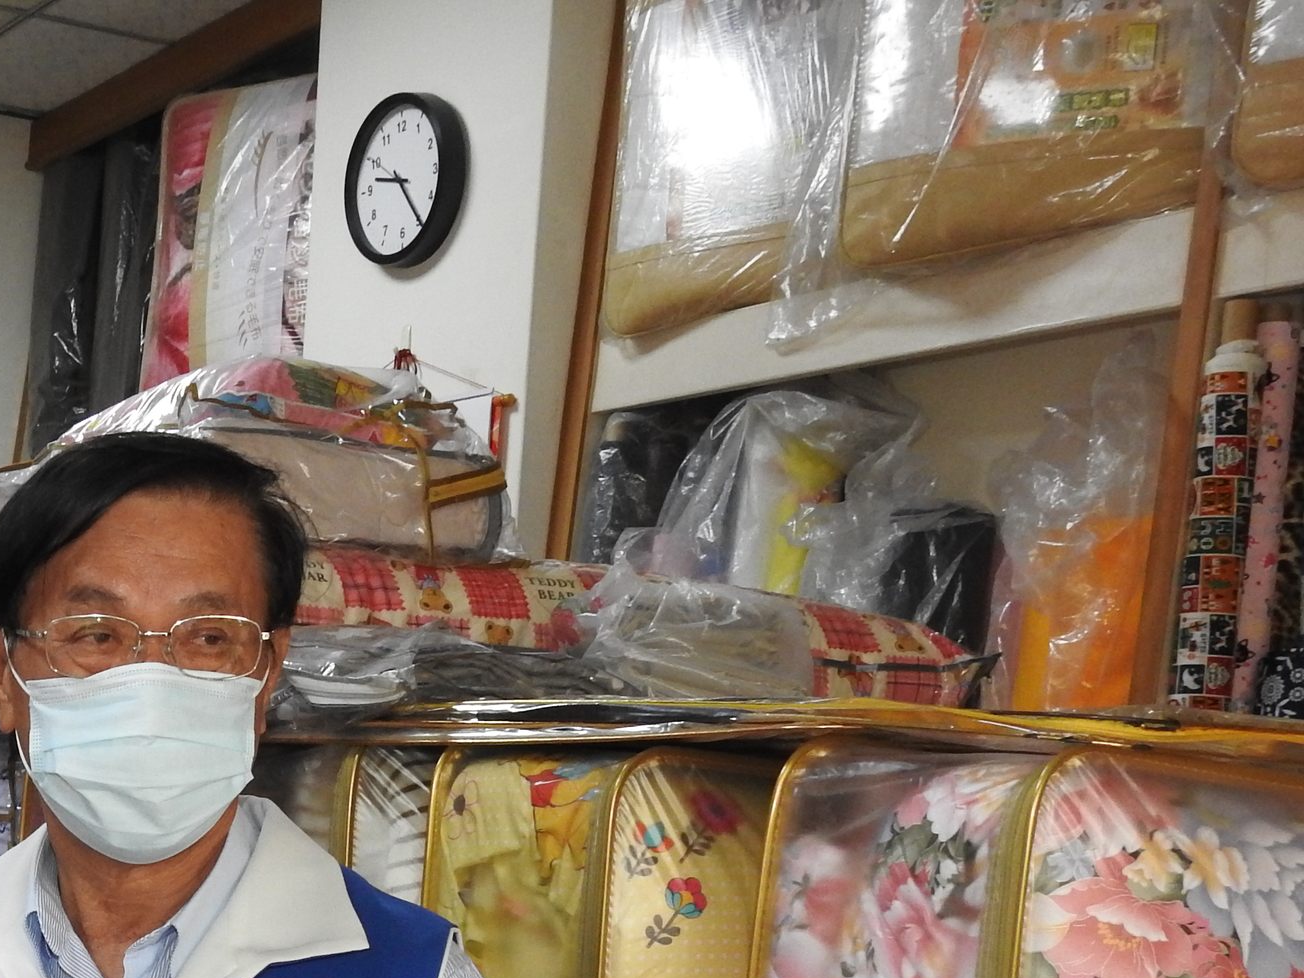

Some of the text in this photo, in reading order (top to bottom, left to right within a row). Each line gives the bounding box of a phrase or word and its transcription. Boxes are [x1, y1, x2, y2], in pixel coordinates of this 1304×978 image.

[397, 120, 407, 133] 12
[382, 134, 391, 146] 11
[427, 138, 433, 150] 2
[371, 157, 382, 170] 10
[432, 163, 438, 175] 3
[367, 185, 373, 197] 9
[428, 190, 434, 200] 4
[371, 209, 377, 221] 8
[382, 225, 388, 237] 7
[399, 227, 405, 239] 6
[525, 576, 576, 589] TEDDY
